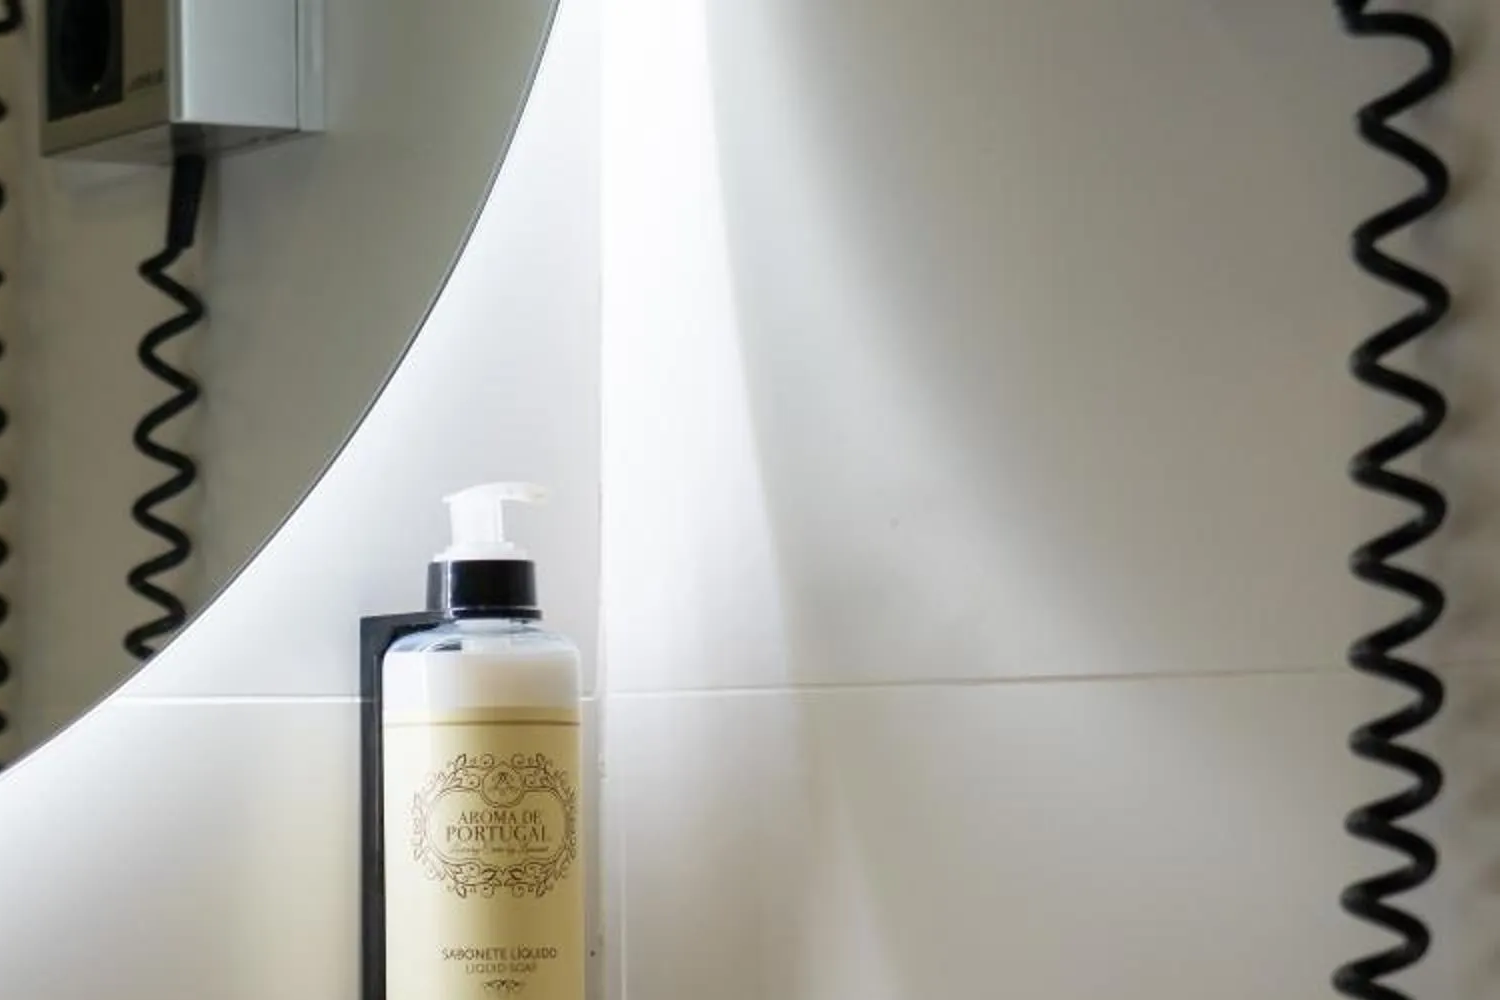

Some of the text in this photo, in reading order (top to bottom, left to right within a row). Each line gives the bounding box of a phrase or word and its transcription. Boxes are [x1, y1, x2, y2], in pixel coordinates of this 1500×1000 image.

[459, 809, 542, 825] AROMA DE
[446, 824, 549, 843] PORTUGAL
[441, 947, 508, 961] SABONETE
[465, 962, 508, 975] LIQUID
